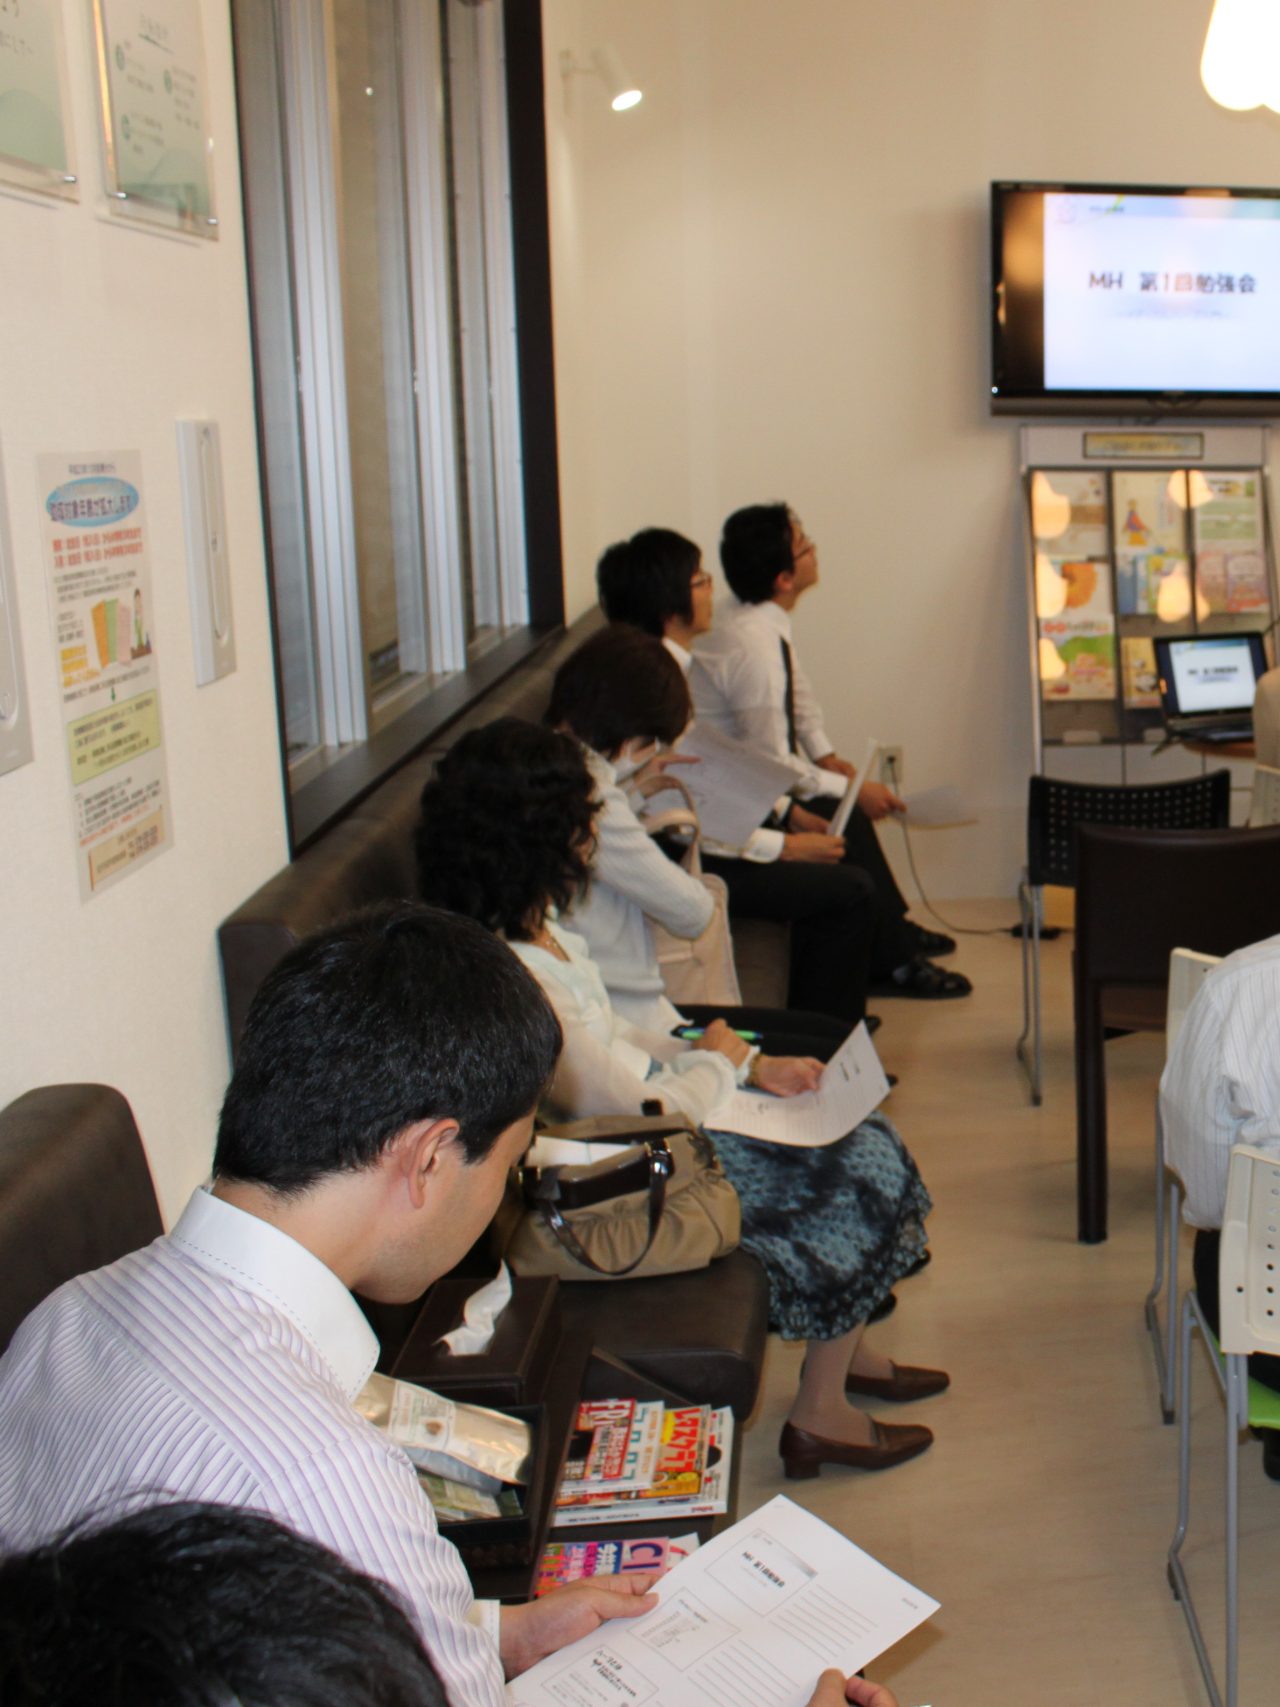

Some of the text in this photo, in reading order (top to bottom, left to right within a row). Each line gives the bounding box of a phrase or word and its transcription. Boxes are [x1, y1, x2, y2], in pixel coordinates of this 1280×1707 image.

[1088, 271, 1256, 293] MH 第1回勉強会
